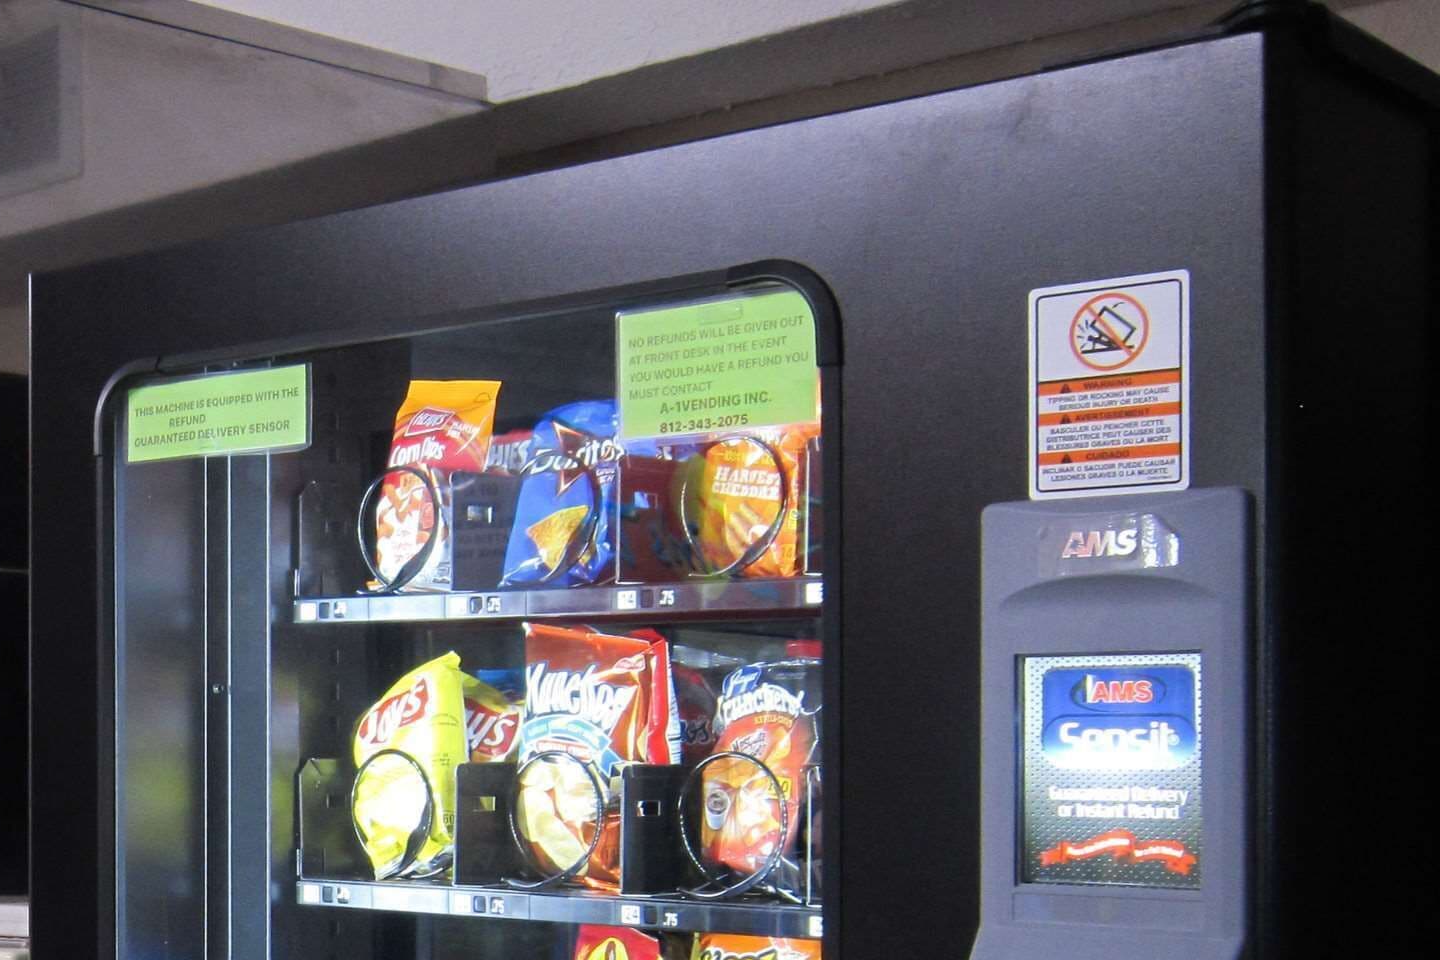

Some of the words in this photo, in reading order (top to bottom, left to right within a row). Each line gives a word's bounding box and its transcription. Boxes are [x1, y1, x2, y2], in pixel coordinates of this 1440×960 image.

[628, 338, 644, 349] NO
[647, 332, 696, 345] REFUNDS
[700, 328, 725, 339] WILL
[727, 325, 741, 335] BE
[744, 319, 777, 333] GIVEN
[780, 315, 804, 327] OUT
[629, 355, 642, 366] AT
[644, 350, 680, 364] FRONT
[683, 346, 710, 359] DESK
[713, 344, 724, 355] IN
[727, 341, 748, 353] THE
[751, 336, 788, 350] EVENT
[630, 371, 652, 383] YOU
[654, 366, 694, 381] WOULD
[696, 361, 724, 374] HAVE
[727, 360, 734, 371] A
[738, 355, 782, 369] REFUND
[785, 351, 809, 363] YOU
[629, 386, 658, 400] MUST
[662, 381, 713, 396] CONTACT
[744, 391, 773, 405] INC.
[1083, 379, 1132, 390] WARNING
[134, 406, 154, 418] THIS
[156, 402, 196, 415] MACHINE
[196, 399, 205, 408] IS
[207, 394, 253, 408] EQUIPPED
[255, 391, 280, 401] WITH
[281, 387, 299, 398] THE
[134, 430, 196, 448] GUARANTEED
[197, 424, 245, 440] DELIVERY
[248, 420, 290, 434] SENSOR
[169, 414, 206, 428] REFUND
[660, 414, 748, 433] 812-343-2075
[1062, 528, 1137, 559] AMS
